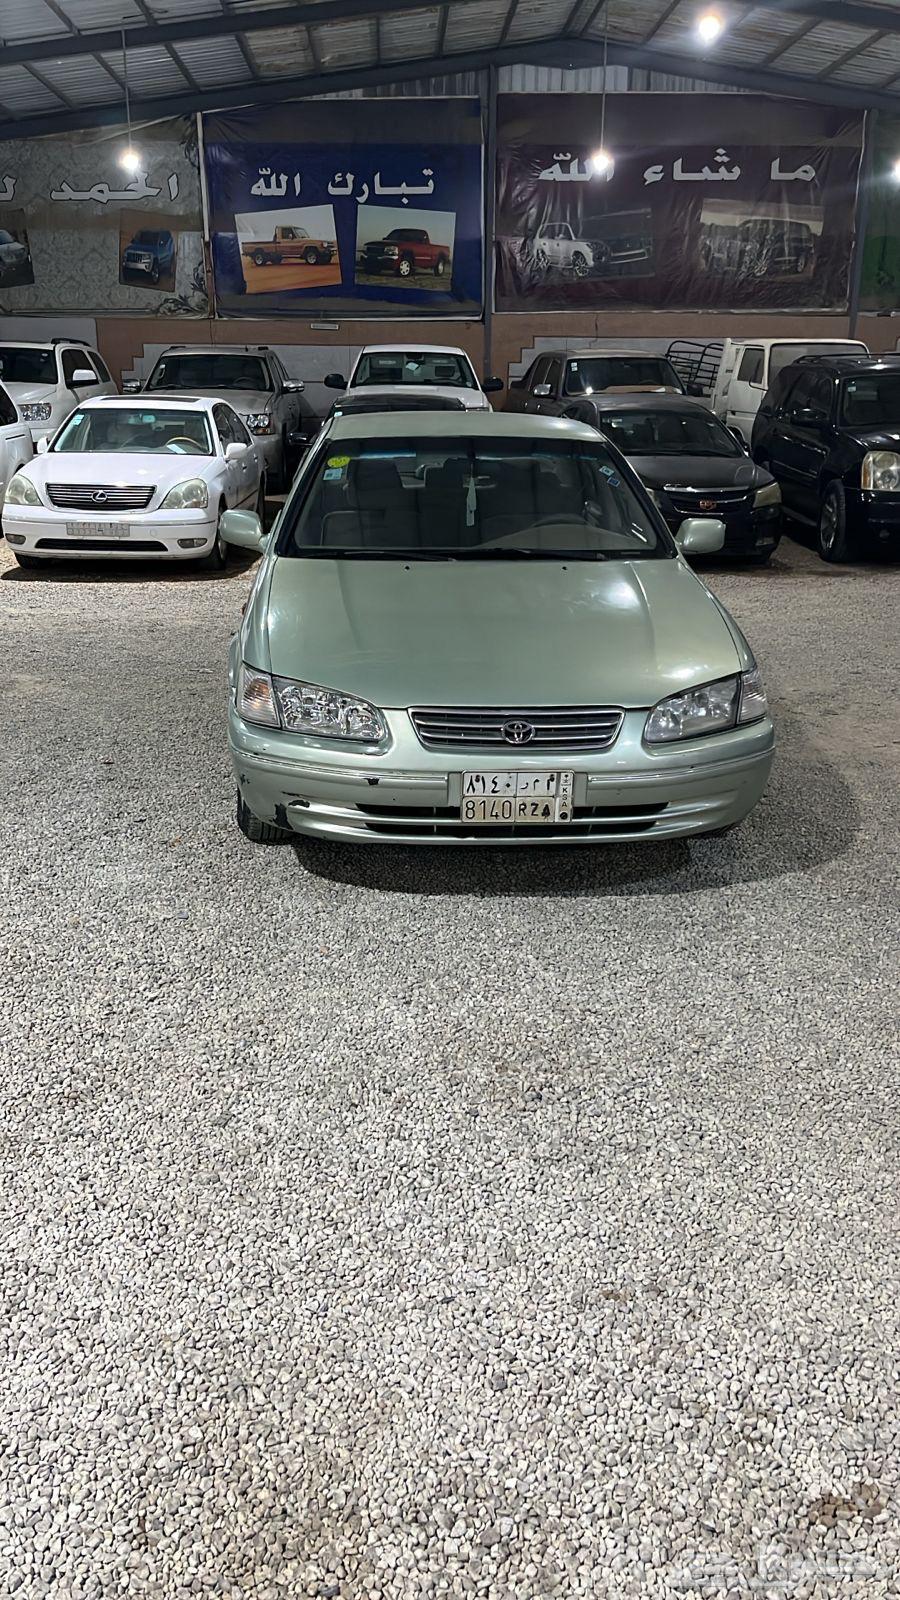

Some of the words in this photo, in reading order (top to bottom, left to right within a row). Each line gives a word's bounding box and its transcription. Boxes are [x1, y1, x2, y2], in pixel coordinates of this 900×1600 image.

[250, 167, 301, 196] الله
[643, 148, 741, 185] شاء
[770, 157, 816, 181] ما
[51, 171, 179, 204] الحمد
[327, 168, 435, 205] تبارك
[465, 800, 512, 820] 8140
